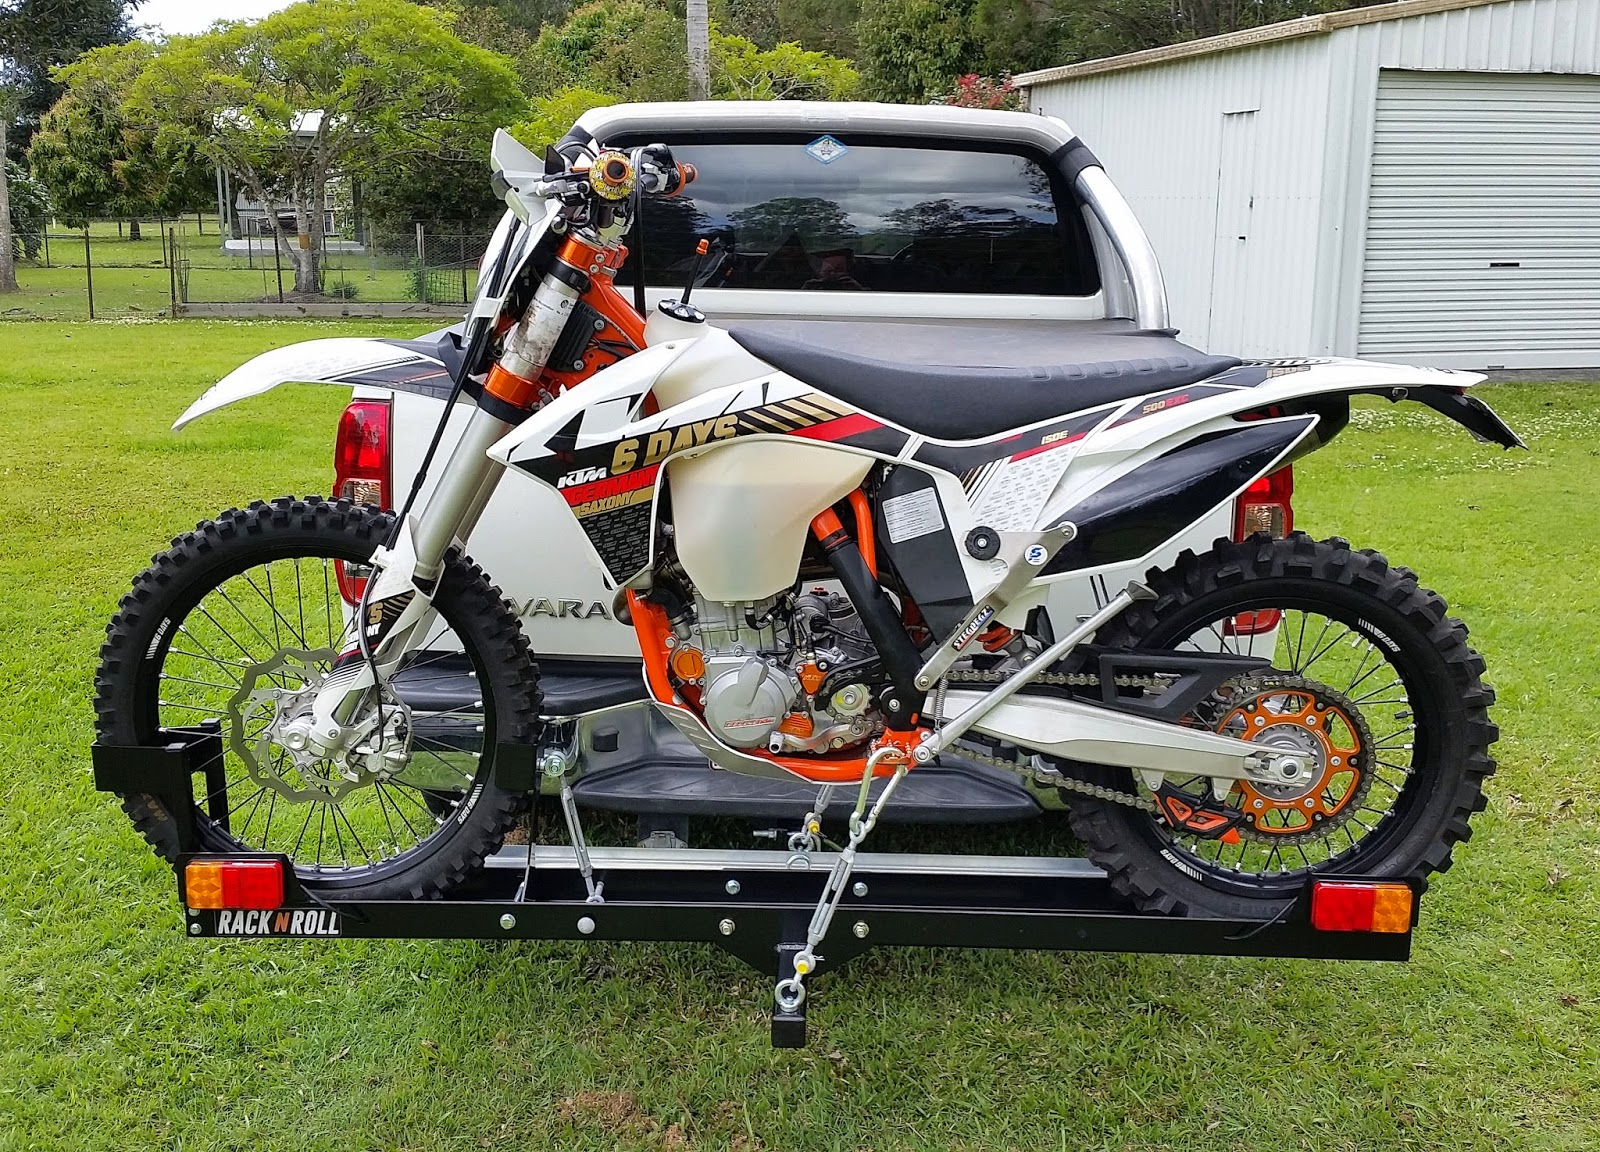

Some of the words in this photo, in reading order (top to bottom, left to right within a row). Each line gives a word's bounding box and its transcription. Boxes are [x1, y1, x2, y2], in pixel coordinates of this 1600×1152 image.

[610, 438, 640, 476] 6
[643, 414, 738, 466] DAYS
[557, 466, 607, 489] KTM
[579, 490, 635, 516] SAXONY
[218, 910, 274, 935] RACK
[274, 911, 290, 933] N
[290, 910, 340, 935] ROLL
